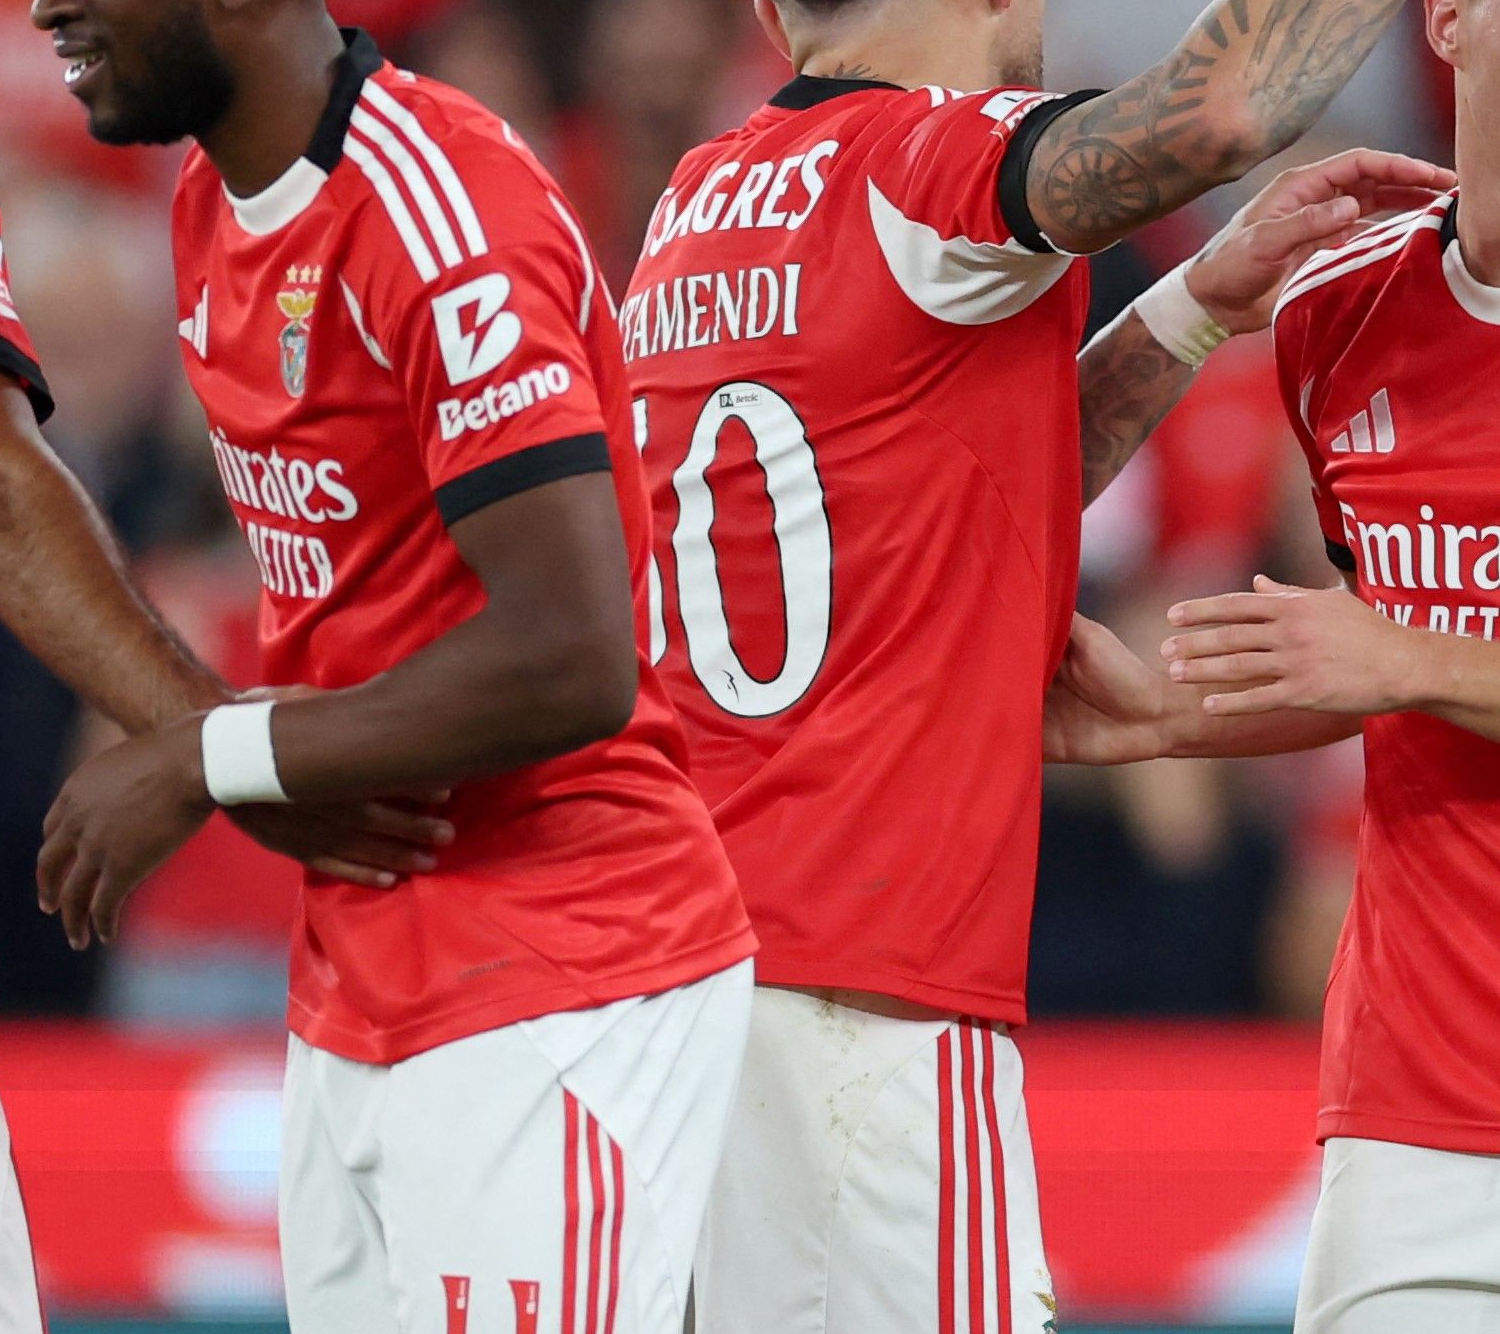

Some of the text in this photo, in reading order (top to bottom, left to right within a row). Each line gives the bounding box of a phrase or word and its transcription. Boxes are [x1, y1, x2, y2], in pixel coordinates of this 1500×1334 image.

[649, 139, 840, 258] SAGRES
[619, 263, 802, 365] TAMENDI
[436, 362, 571, 442] Betano
[209, 425, 359, 524] mirates
